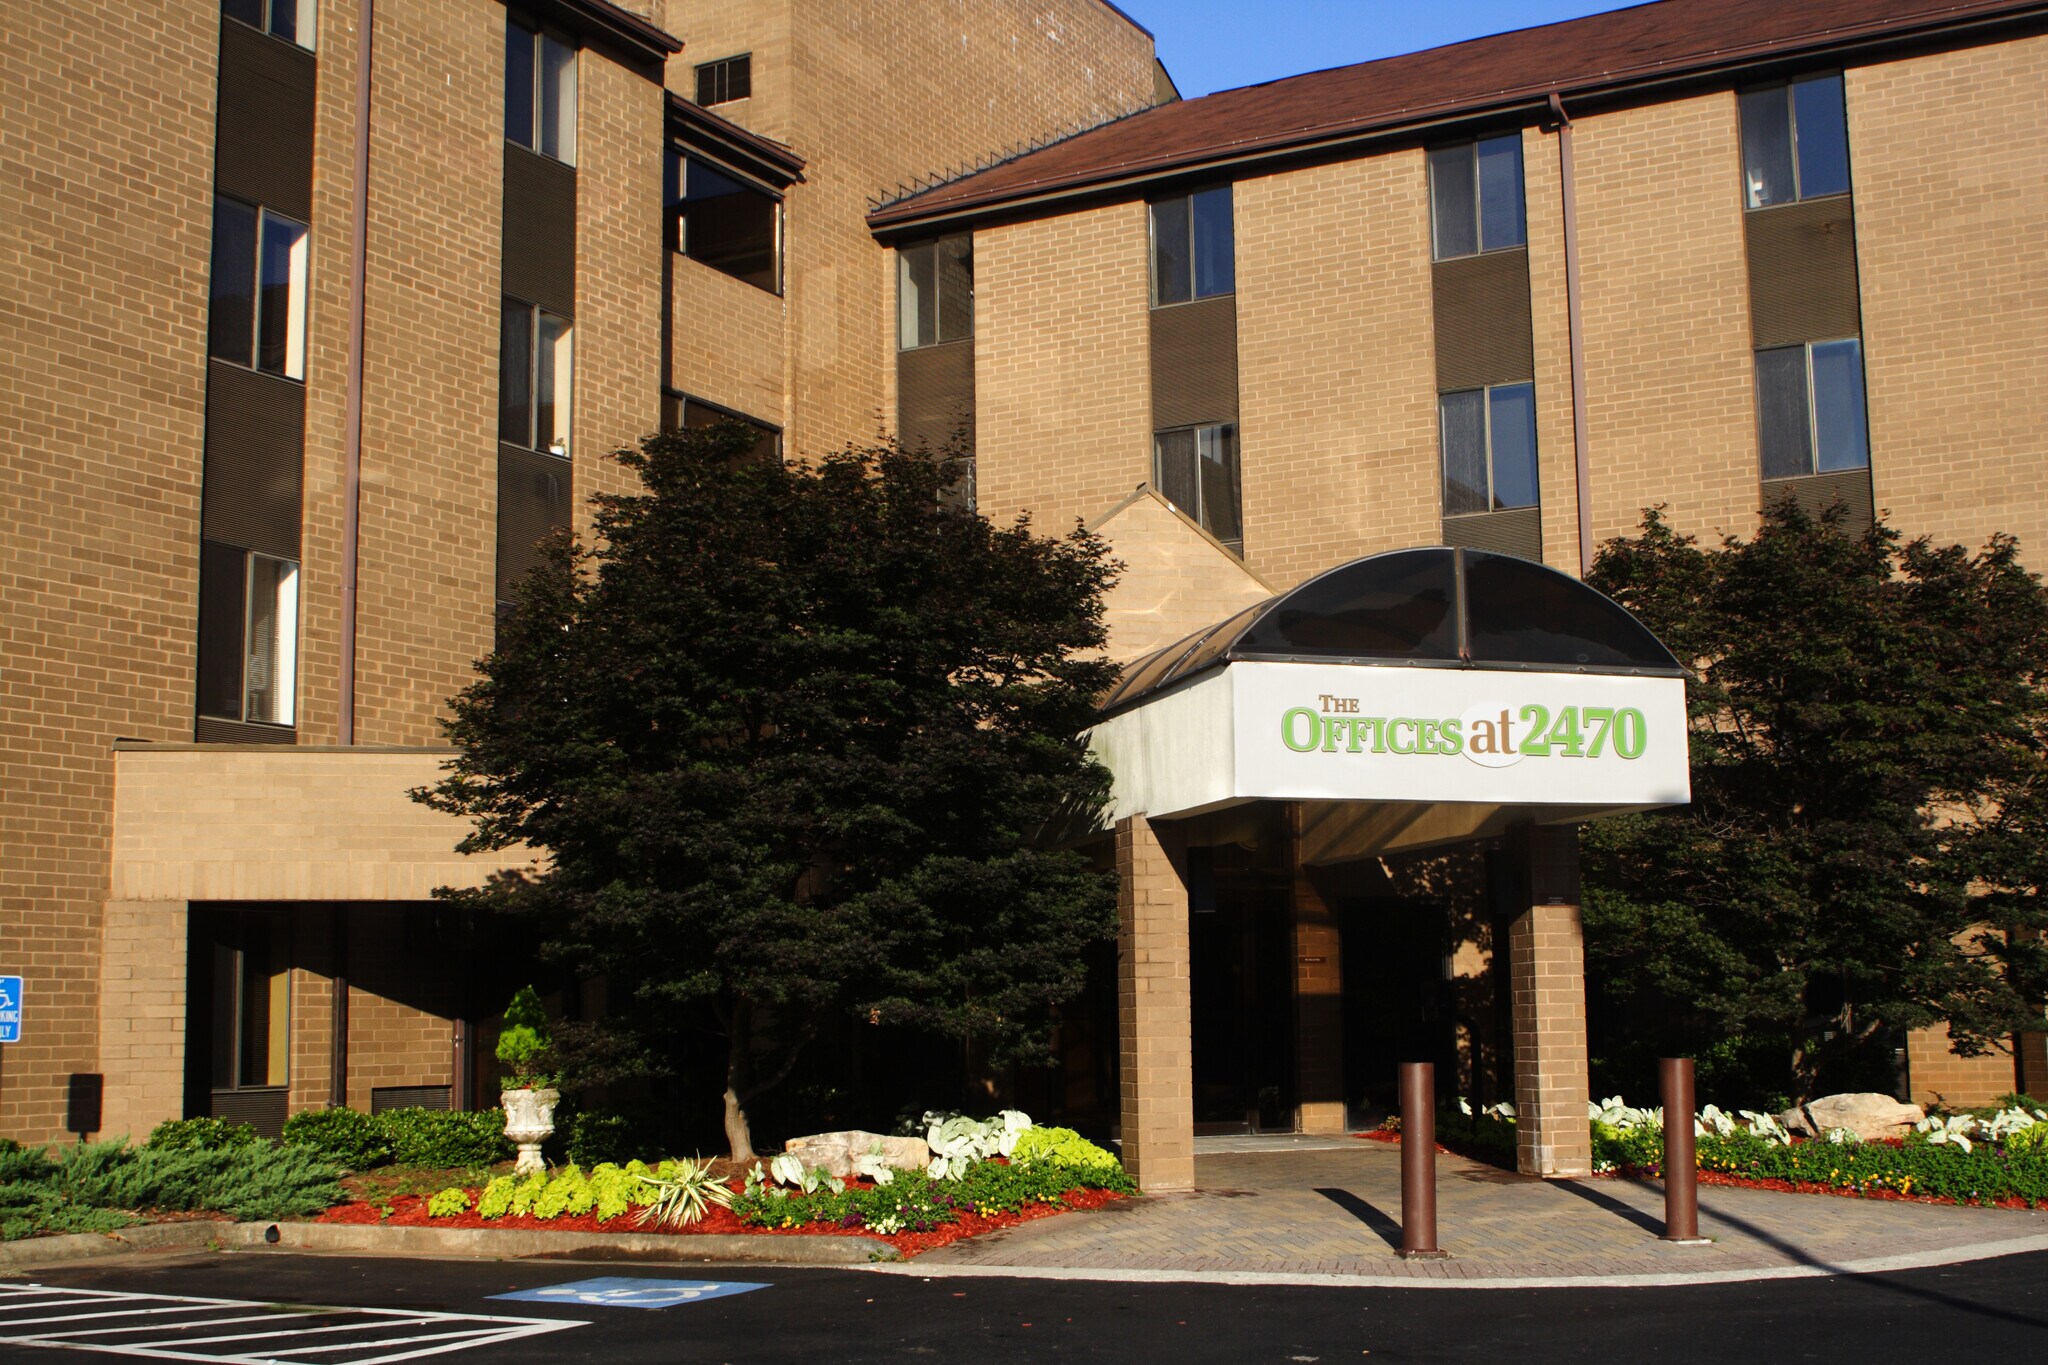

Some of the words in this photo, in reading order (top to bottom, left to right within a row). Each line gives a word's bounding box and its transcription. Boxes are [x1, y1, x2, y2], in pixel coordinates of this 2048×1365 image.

[1318, 694, 1360, 713] THE
[1281, 707, 1464, 754] OFFICES
[1469, 708, 1517, 755] at
[1518, 703, 1648, 759] 2470
